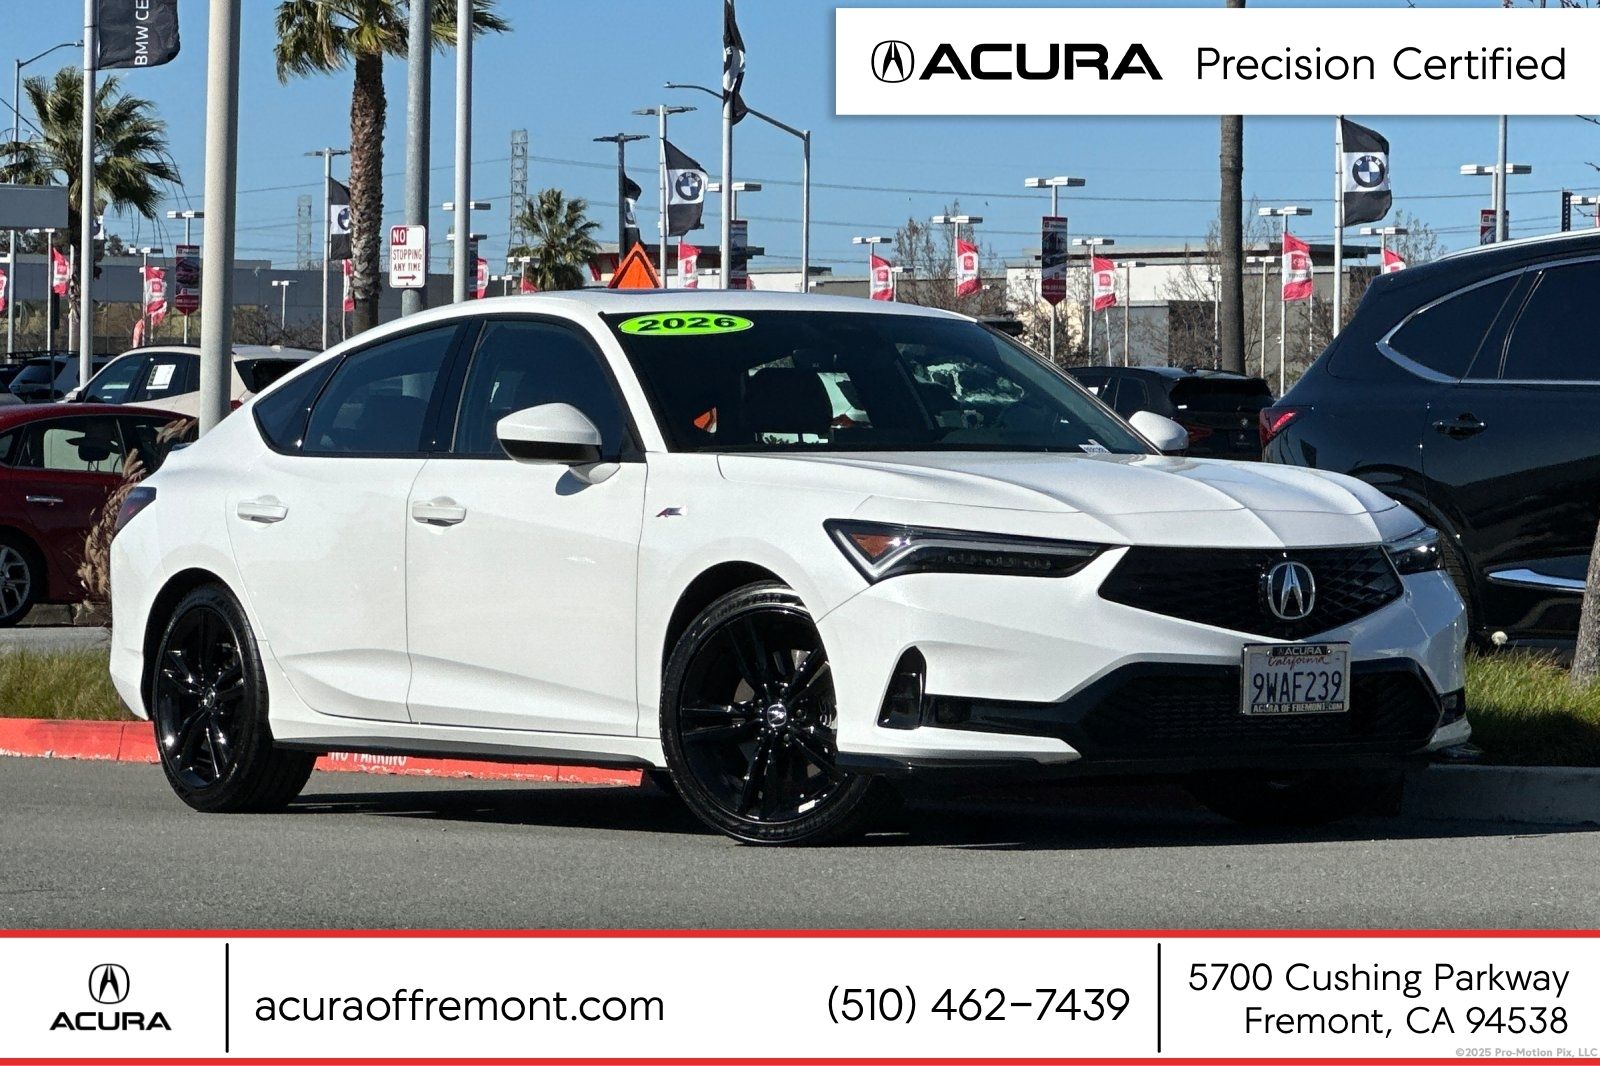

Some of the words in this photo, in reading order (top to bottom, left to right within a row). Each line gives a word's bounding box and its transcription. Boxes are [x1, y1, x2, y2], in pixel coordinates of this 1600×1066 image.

[134, 26, 149, 65] BMW
[393, 229, 406, 243] NO
[393, 249, 422, 260] STOPPING
[394, 263, 405, 271] ANY
[408, 263, 421, 271] TIME
[637, 316, 738, 332] 2026
[1284, 646, 1322, 656] ACURA
[1268, 655, 1330, 670] California
[1253, 671, 1342, 703] 9WAF239
[1252, 704, 1279, 713] ACURA
[1280, 703, 1291, 713] OF
